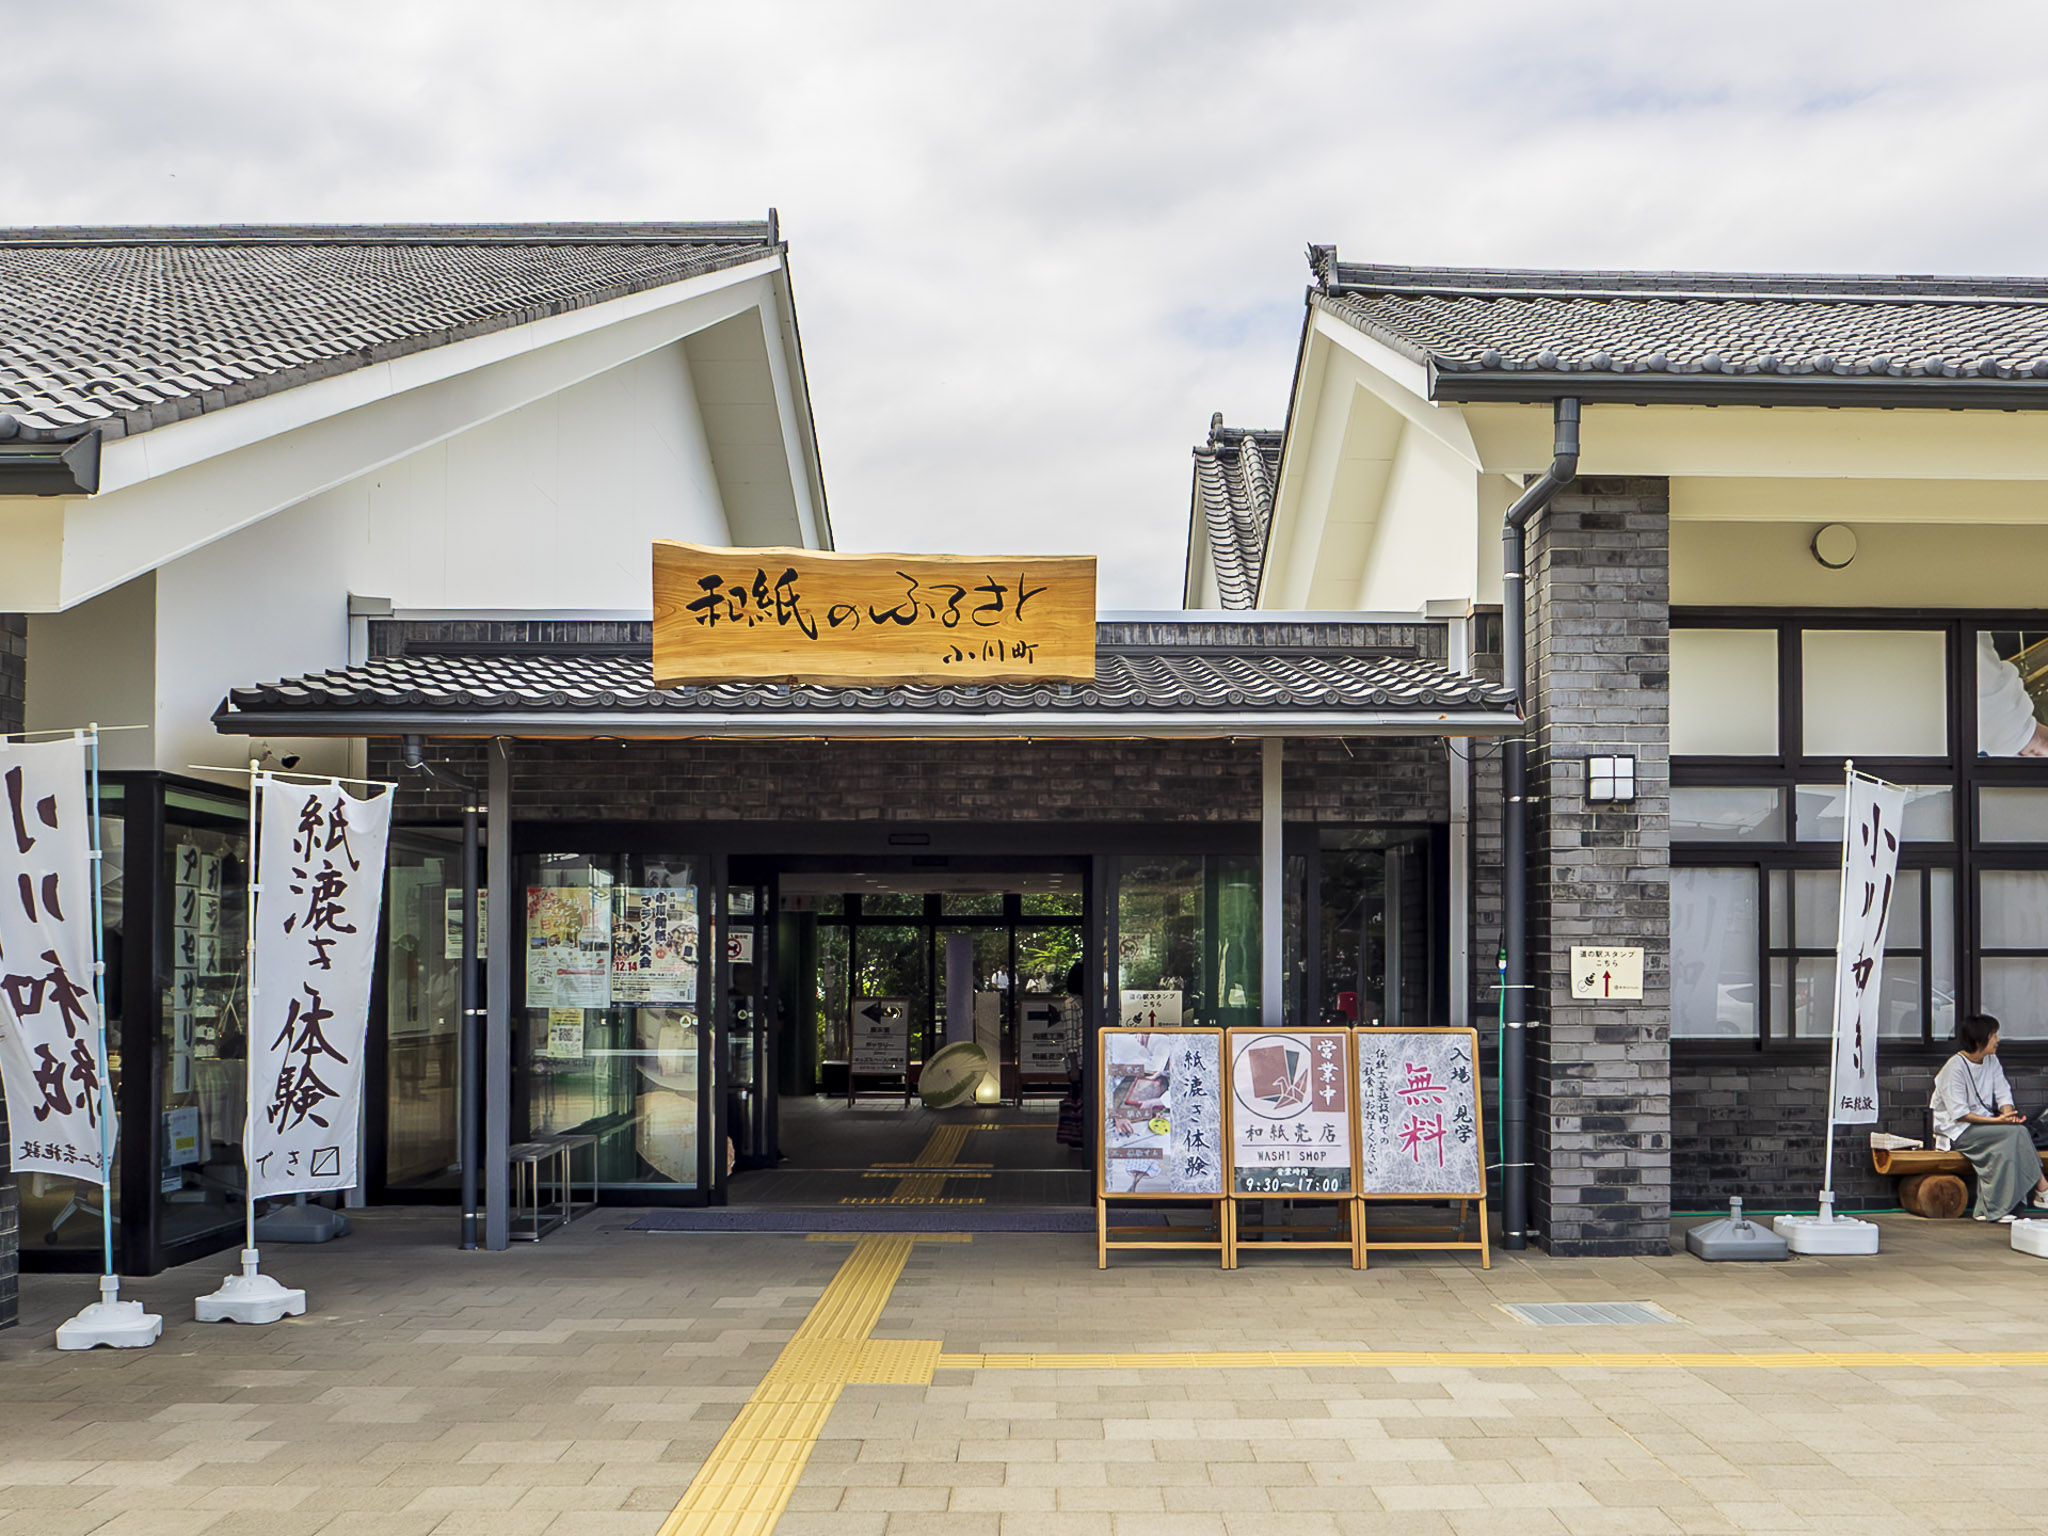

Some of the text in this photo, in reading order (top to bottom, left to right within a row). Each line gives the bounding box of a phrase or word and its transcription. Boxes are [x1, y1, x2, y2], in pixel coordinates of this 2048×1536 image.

[686, 566, 1048, 640] 和紙のふるさと
[943, 639, 1039, 664] 小川町
[180, 847, 198, 1091] アクセサリー
[267, 794, 360, 1135] 紙漉き体験
[640, 896, 652, 969] マラソン大会
[1317, 1039, 1339, 1107] 営業中
[1450, 1047, 1473, 1144] 入場・見学
[1183, 1050, 1210, 1178] 紙漉き体験
[1245, 1122, 1336, 1143] 和紙売店
[1397, 1062, 1447, 1167] 無料
[1258, 1151, 1327, 1161] WASHI SHOP
[1276, 1167, 1309, 1176] 営業時間
